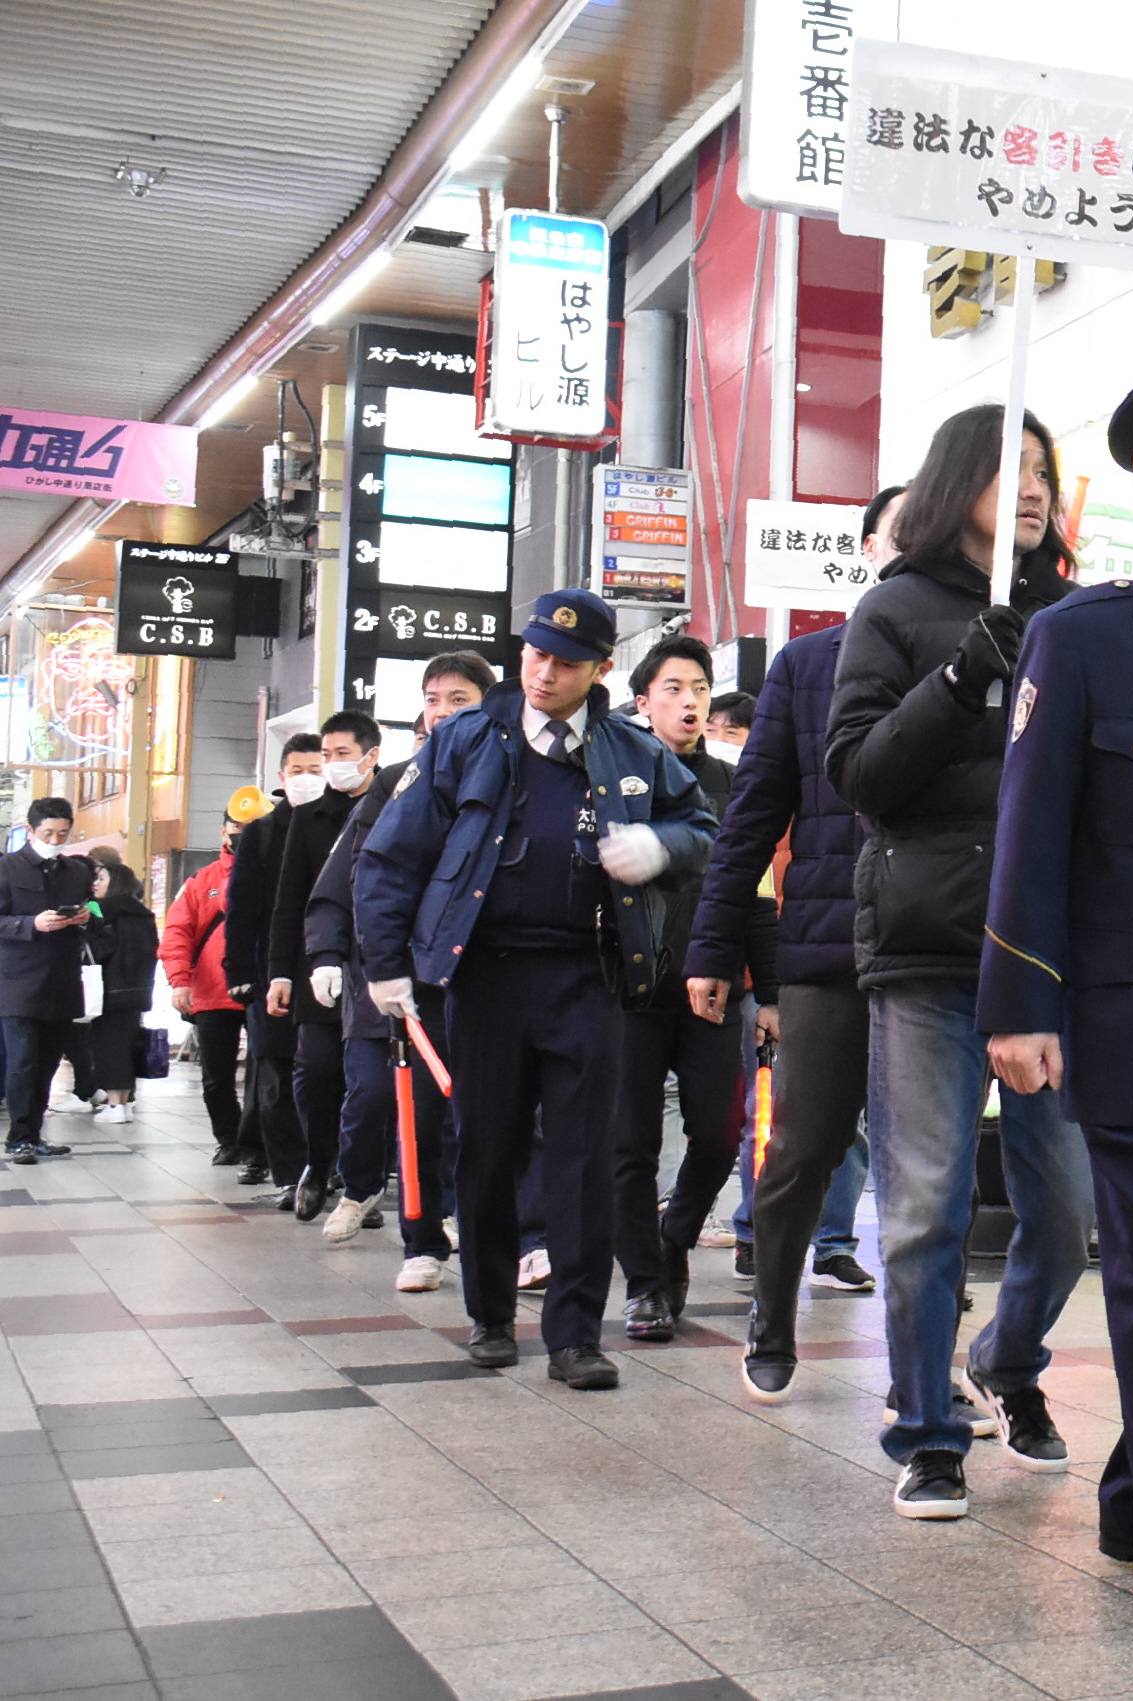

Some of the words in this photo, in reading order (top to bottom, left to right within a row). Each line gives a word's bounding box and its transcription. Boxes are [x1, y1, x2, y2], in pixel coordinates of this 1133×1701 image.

[796, 0, 853, 186] 壱番館
[557, 280, 593, 406] はやし源
[367, 346, 492, 374] ステージ中通り
[362, 404, 387, 428] 5F
[25, 475, 114, 493] ひがし中通り商店街
[358, 472, 384, 495] 4F
[626, 515, 678, 528] GRIFFIN
[633, 531, 684, 543] GRIFFIN
[760, 529, 865, 556] 違法な客
[355, 539, 381, 564] 3F
[823, 562, 878, 585] やめ
[354, 608, 380, 632] 2F
[423, 610, 497, 635] C.S.B
[140, 624, 214, 647] C.S.B
[352, 678, 376, 700] 1F
